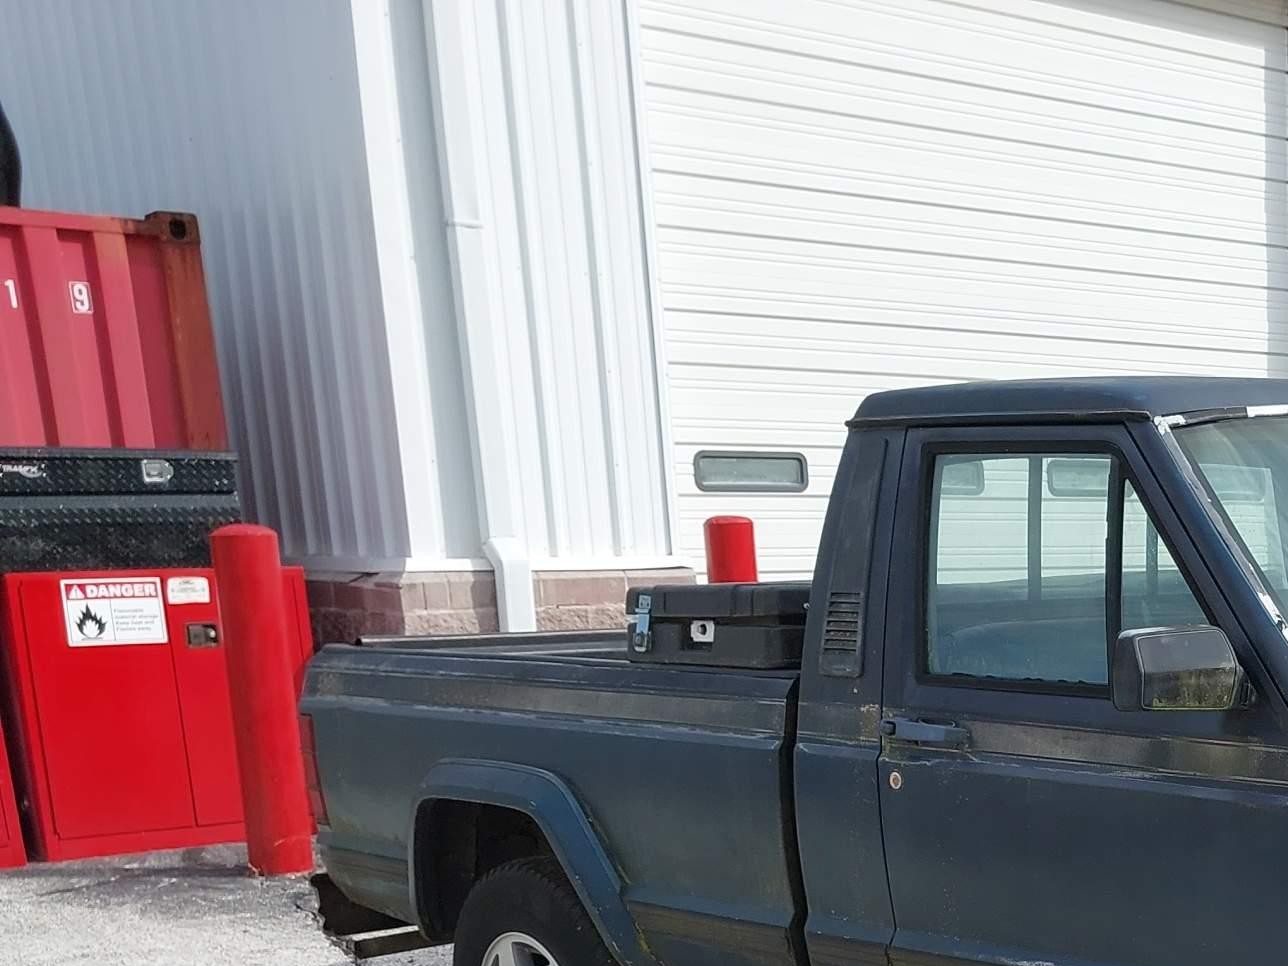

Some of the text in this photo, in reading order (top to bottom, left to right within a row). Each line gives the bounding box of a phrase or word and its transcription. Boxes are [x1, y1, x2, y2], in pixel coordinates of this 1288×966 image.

[4, 279, 90, 312] 1 9
[85, 583, 157, 598] DANGER
